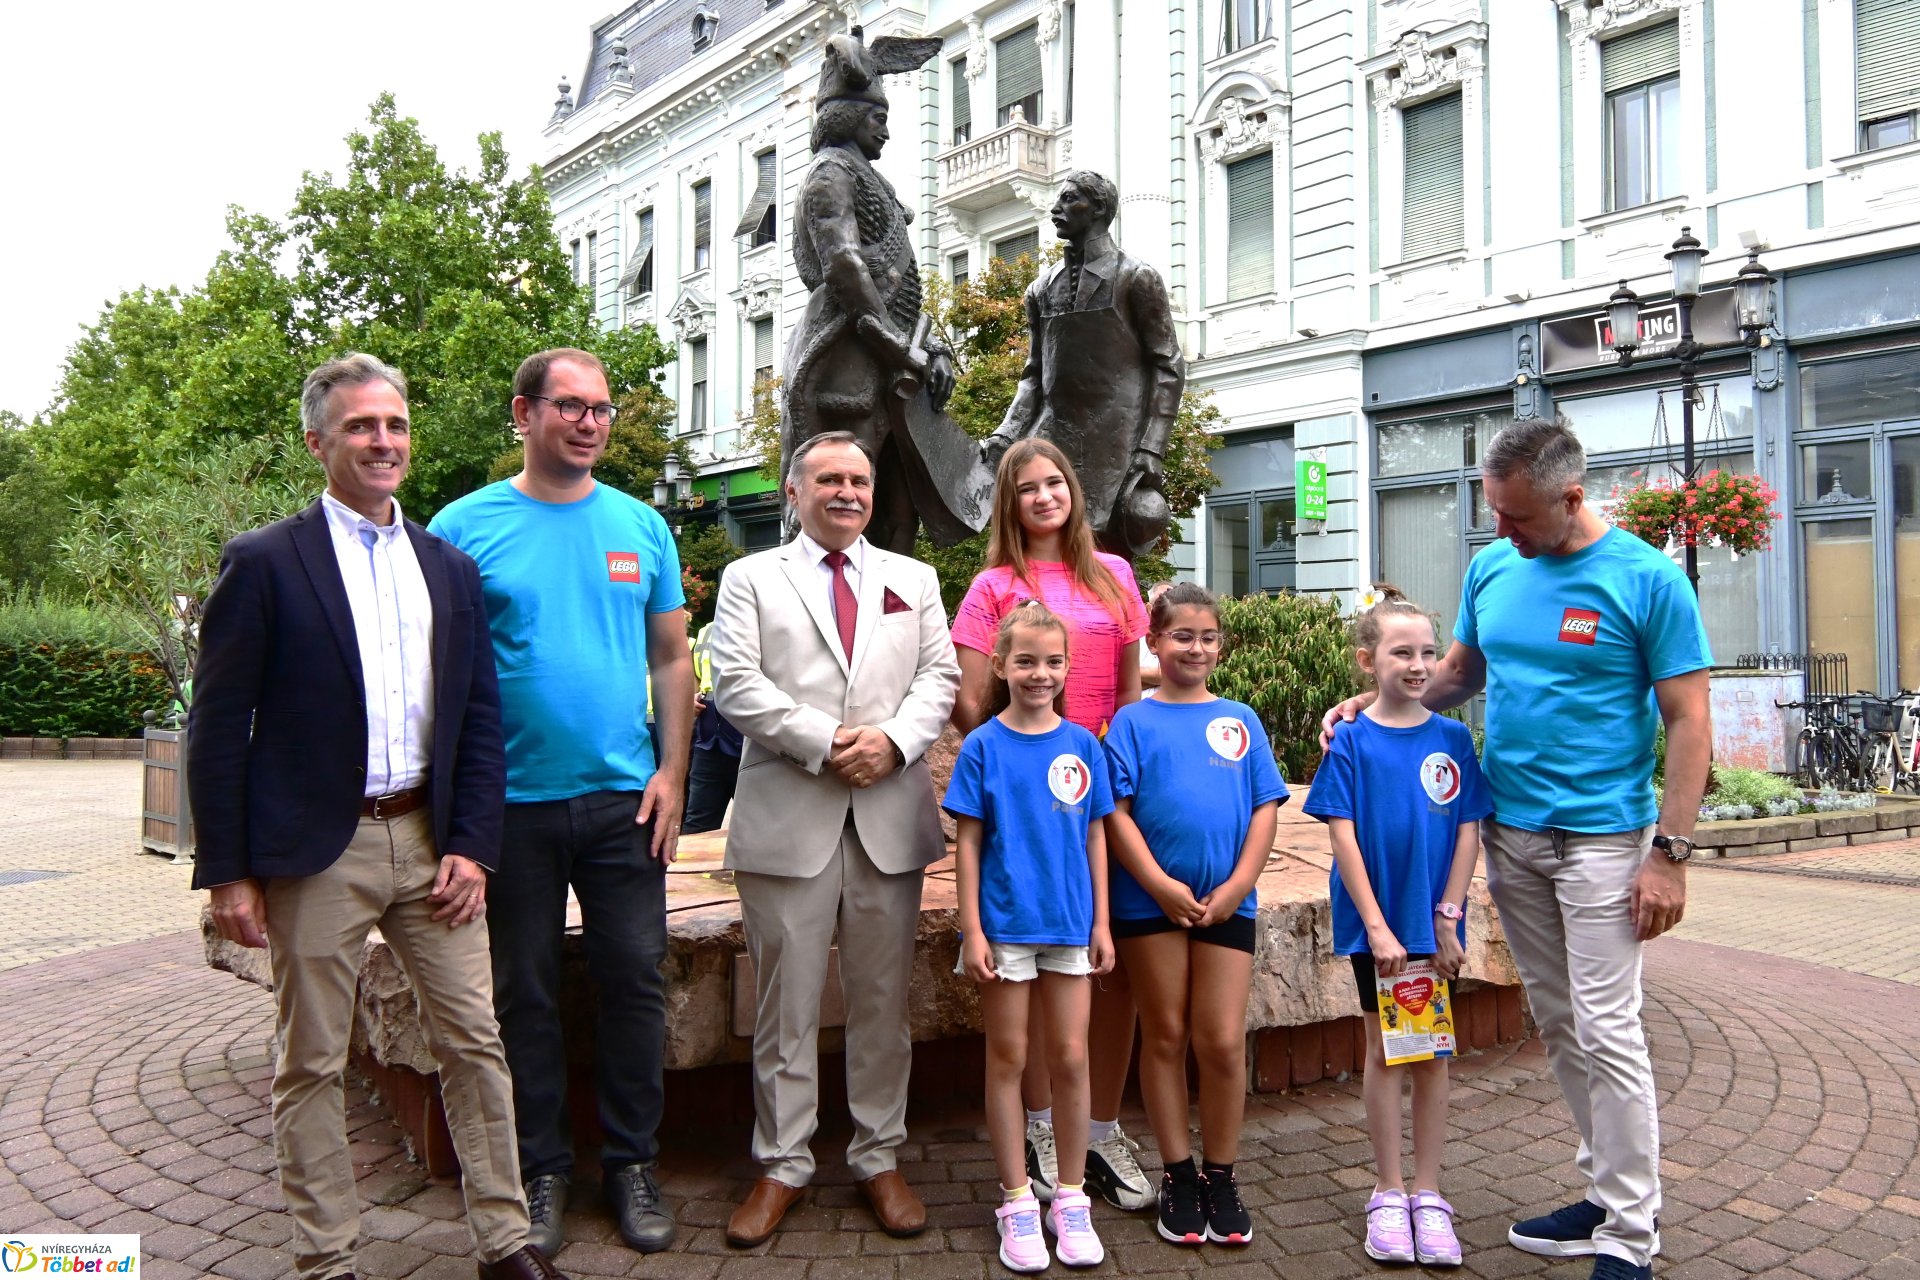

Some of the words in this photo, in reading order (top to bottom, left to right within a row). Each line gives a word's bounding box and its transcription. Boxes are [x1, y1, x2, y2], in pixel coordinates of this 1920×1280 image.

[1604, 314, 1674, 345] MTING
[1641, 346, 1666, 355] MORE
[1306, 494, 1324, 506] 0-24
[610, 560, 639, 574] LEGO
[1562, 617, 1597, 635] LEGO
